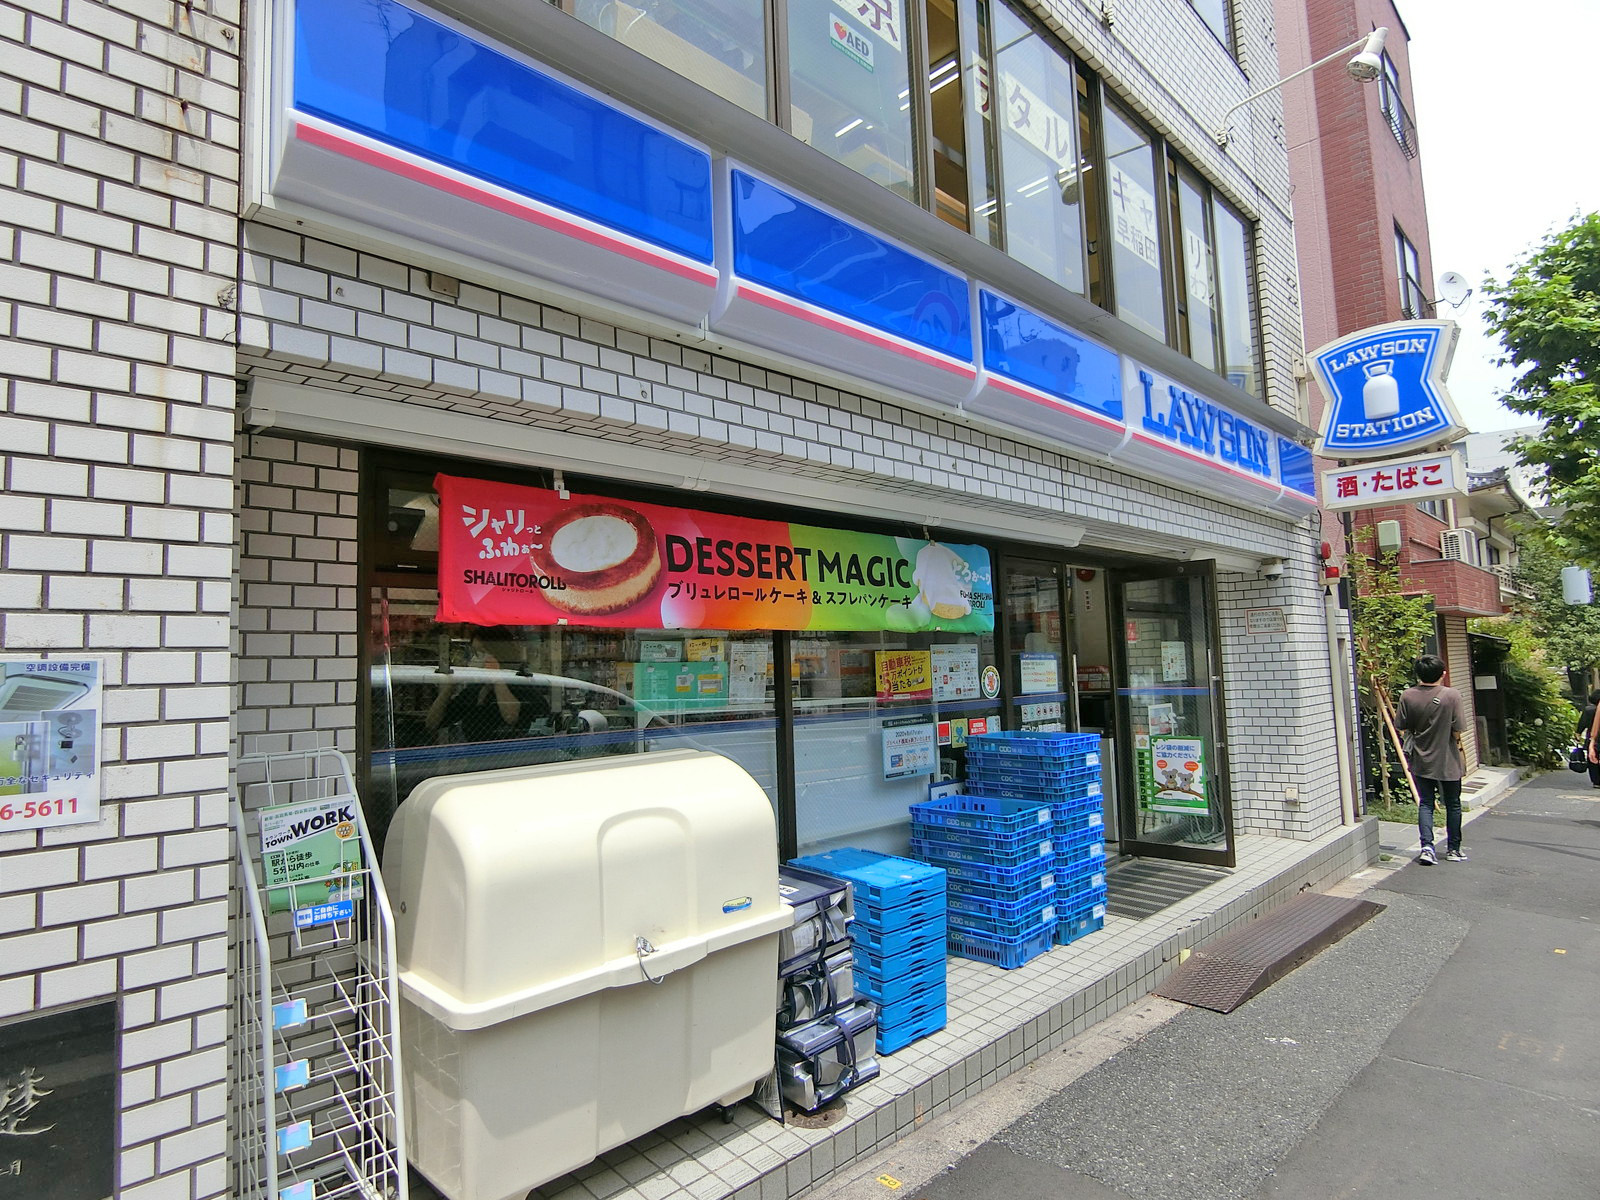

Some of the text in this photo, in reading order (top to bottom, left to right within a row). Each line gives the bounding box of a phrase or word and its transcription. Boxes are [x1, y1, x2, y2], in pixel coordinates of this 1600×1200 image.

[846, 31, 870, 57] AED
[1117, 214, 1156, 267] 早稲田
[1329, 338, 1427, 373] LAWSON
[1139, 369, 1272, 478] LAWSON
[1336, 406, 1435, 438] STATION
[1336, 463, 1443, 498] 酒・たばこ
[462, 505, 541, 538] シャリっと
[665, 534, 912, 589] DESSERT MAGIC
[464, 569, 567, 591] SHALITOROLL
[668, 581, 913, 610] ブリュレロールケーキ & スフレパンケーキ
[25, 663, 91, 672] 空調設備完備
[265, 833, 293, 849] TOWN
[290, 805, 355, 838] WORK
[949, 883, 962, 891] CDC
[314, 904, 339, 914] ご自由に
[314, 909, 352, 921] お持ち下さい
[951, 932, 964, 941] CDC
